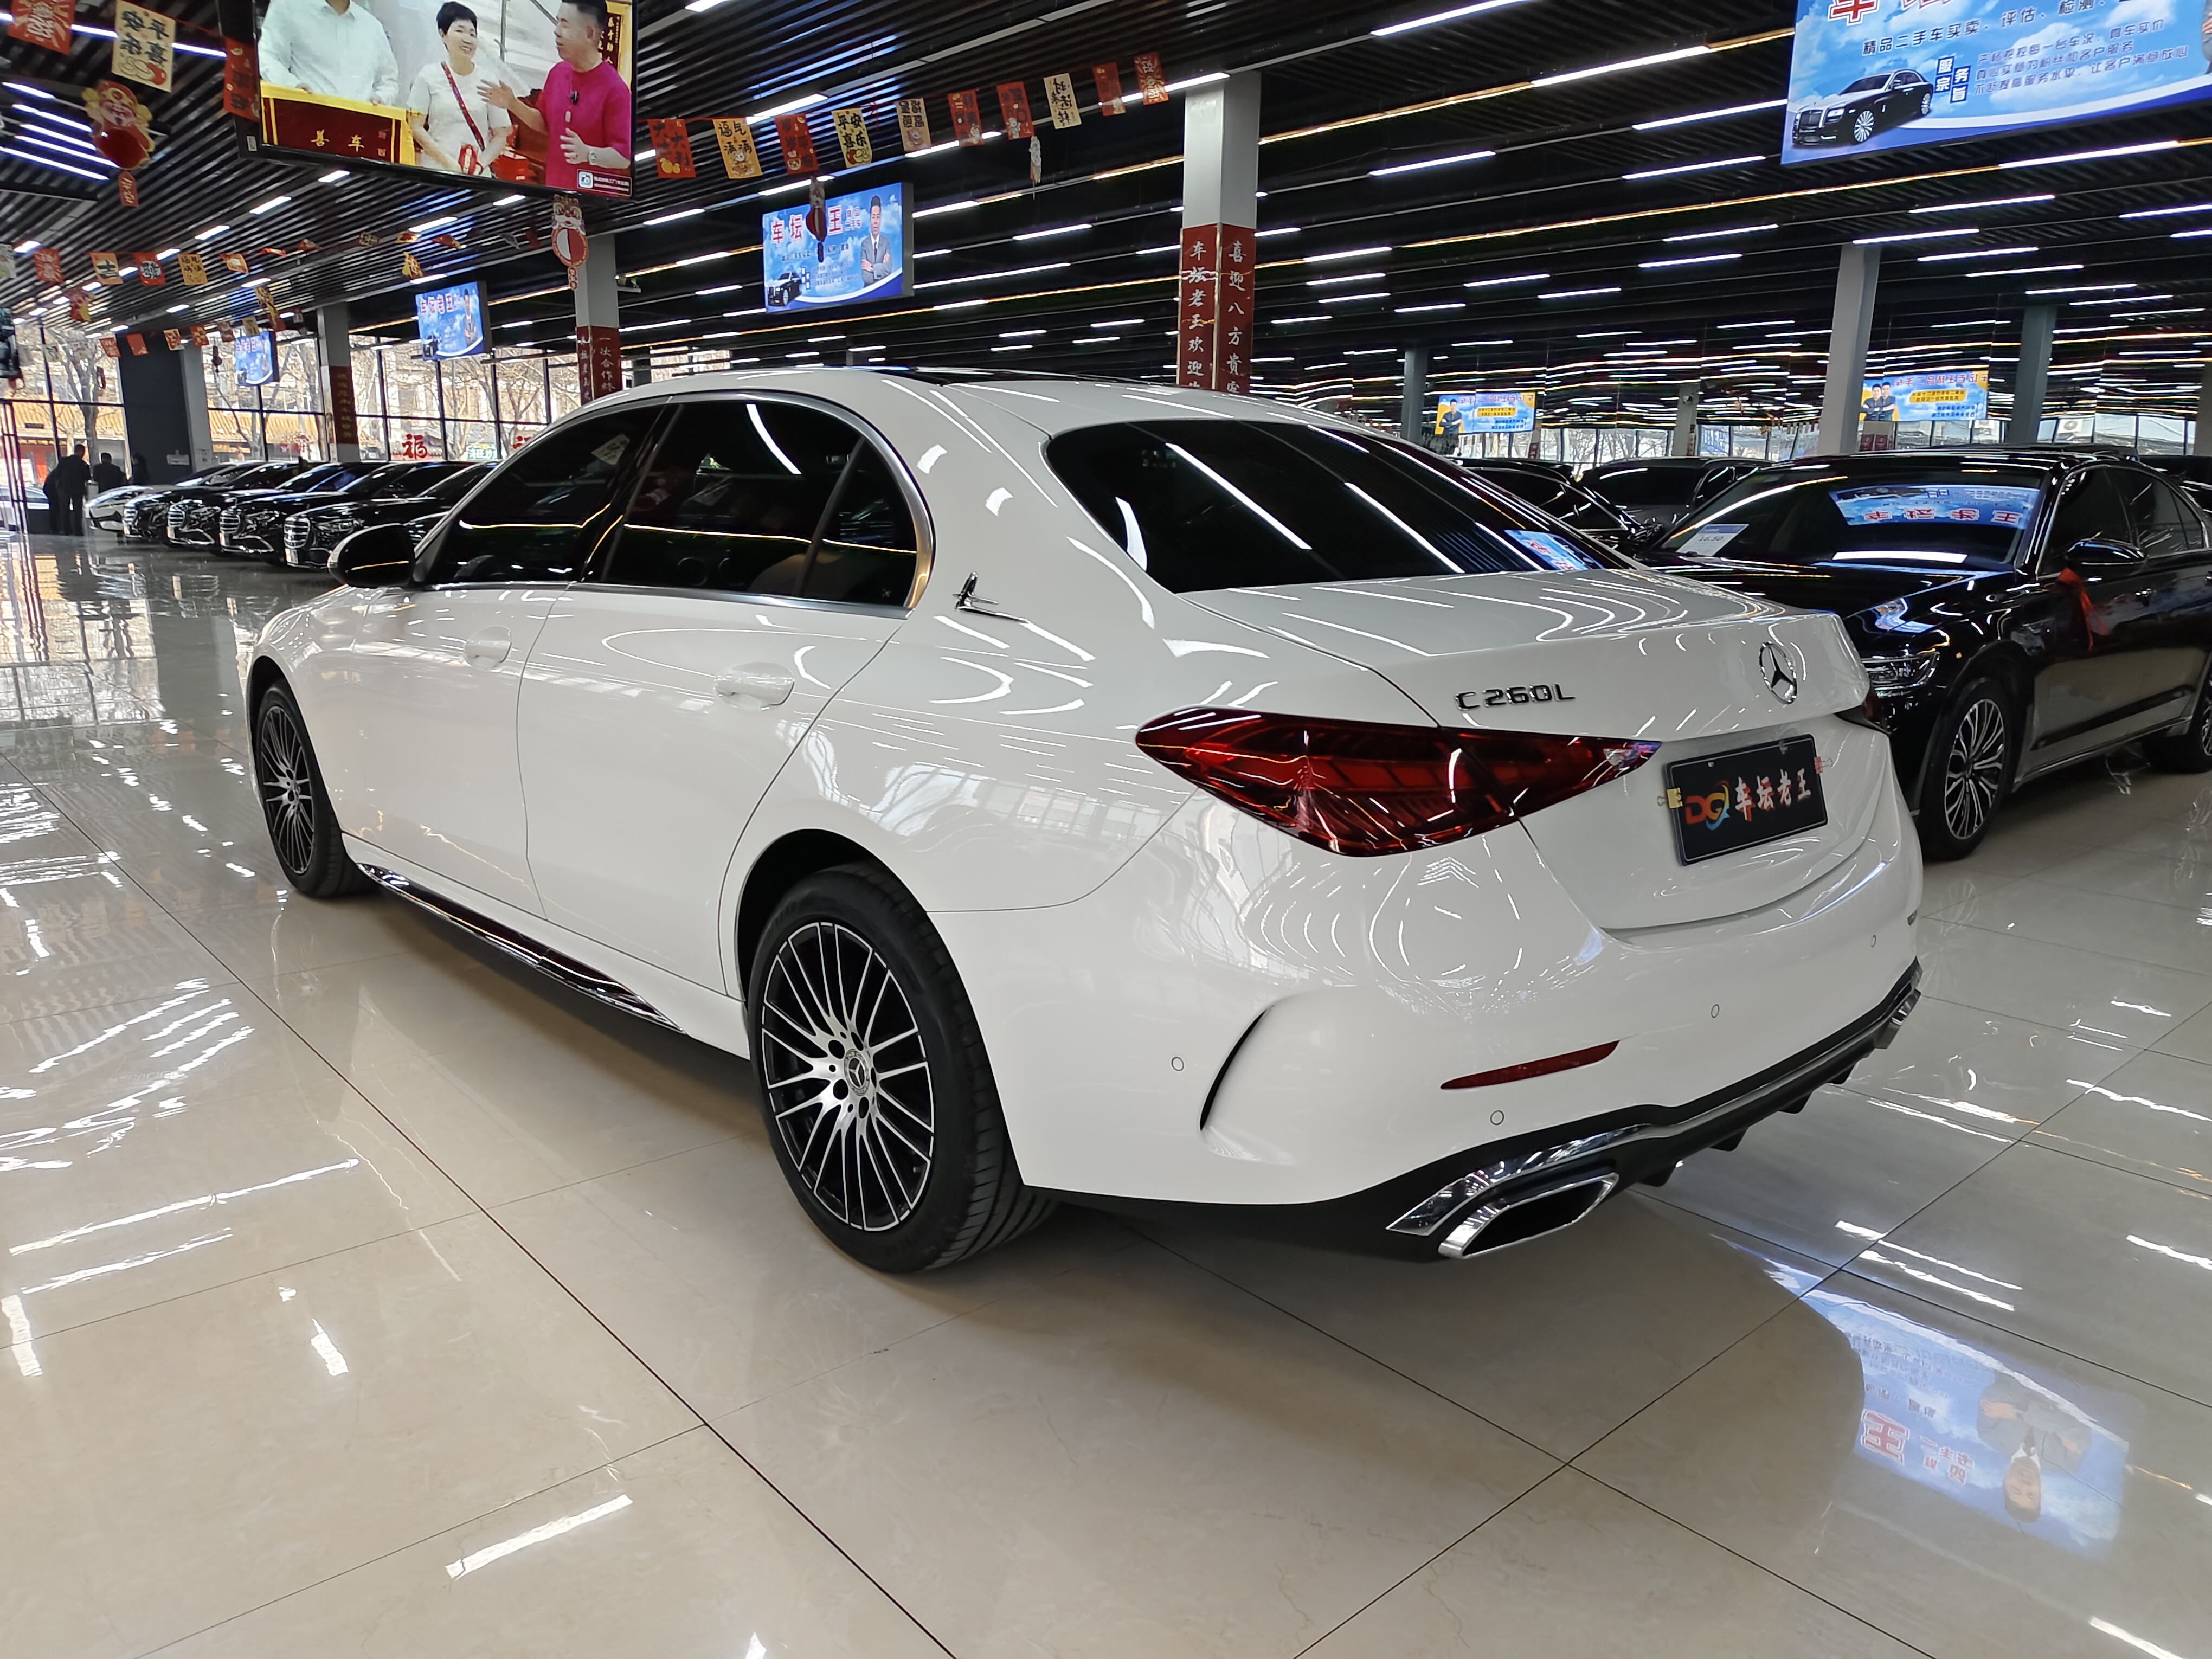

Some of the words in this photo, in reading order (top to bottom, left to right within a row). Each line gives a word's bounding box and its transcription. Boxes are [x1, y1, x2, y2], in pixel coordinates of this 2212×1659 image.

[718, 121, 746, 137] 福气
[771, 206, 842, 246] 车坛王
[402, 434, 427, 460] 福
[1455, 691, 1481, 711] C
[1482, 682, 1576, 707] 260L
[1735, 768, 1811, 821] 车坛老王
